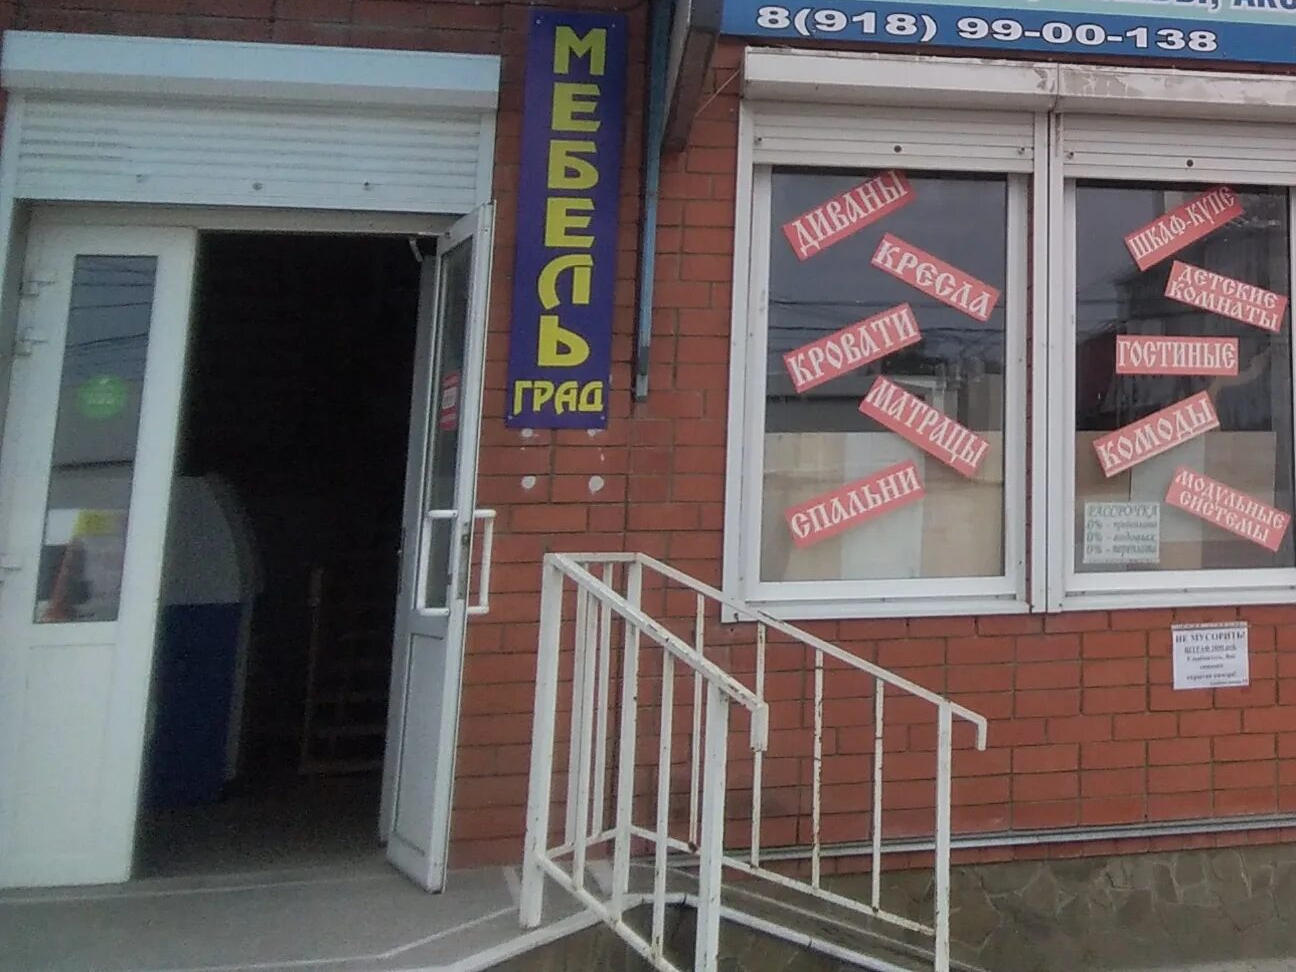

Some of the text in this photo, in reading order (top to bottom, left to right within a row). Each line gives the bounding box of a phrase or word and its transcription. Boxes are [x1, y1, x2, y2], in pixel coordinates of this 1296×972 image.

[757, 6, 1218, 52] 8(918) 99-00-138
[537, 26, 606, 367] МЕБЕЛЬ
[792, 172, 908, 256] ДИВАНЫ
[1128, 186, 1237, 261] ШКАФ-КУПЕ
[872, 238, 989, 319] КРЕСЛА
[1170, 281, 1279, 331] КОМНАТЫ
[1177, 264, 1279, 309] ДЕТСКИЕ
[788, 308, 919, 387] КРОВАТИ
[1118, 339, 1237, 368] ГОСТИНЫЕ
[513, 380, 604, 416] ГРАД
[866, 380, 989, 468] МАТРАЦЫ
[1098, 398, 1215, 469] КОМОДЫ
[790, 466, 921, 537] СПАЛЬНИ
[1176, 467, 1285, 529] МОДУЛЬНЫЕ
[1179, 490, 1269, 542] СИСТЕМЫ
